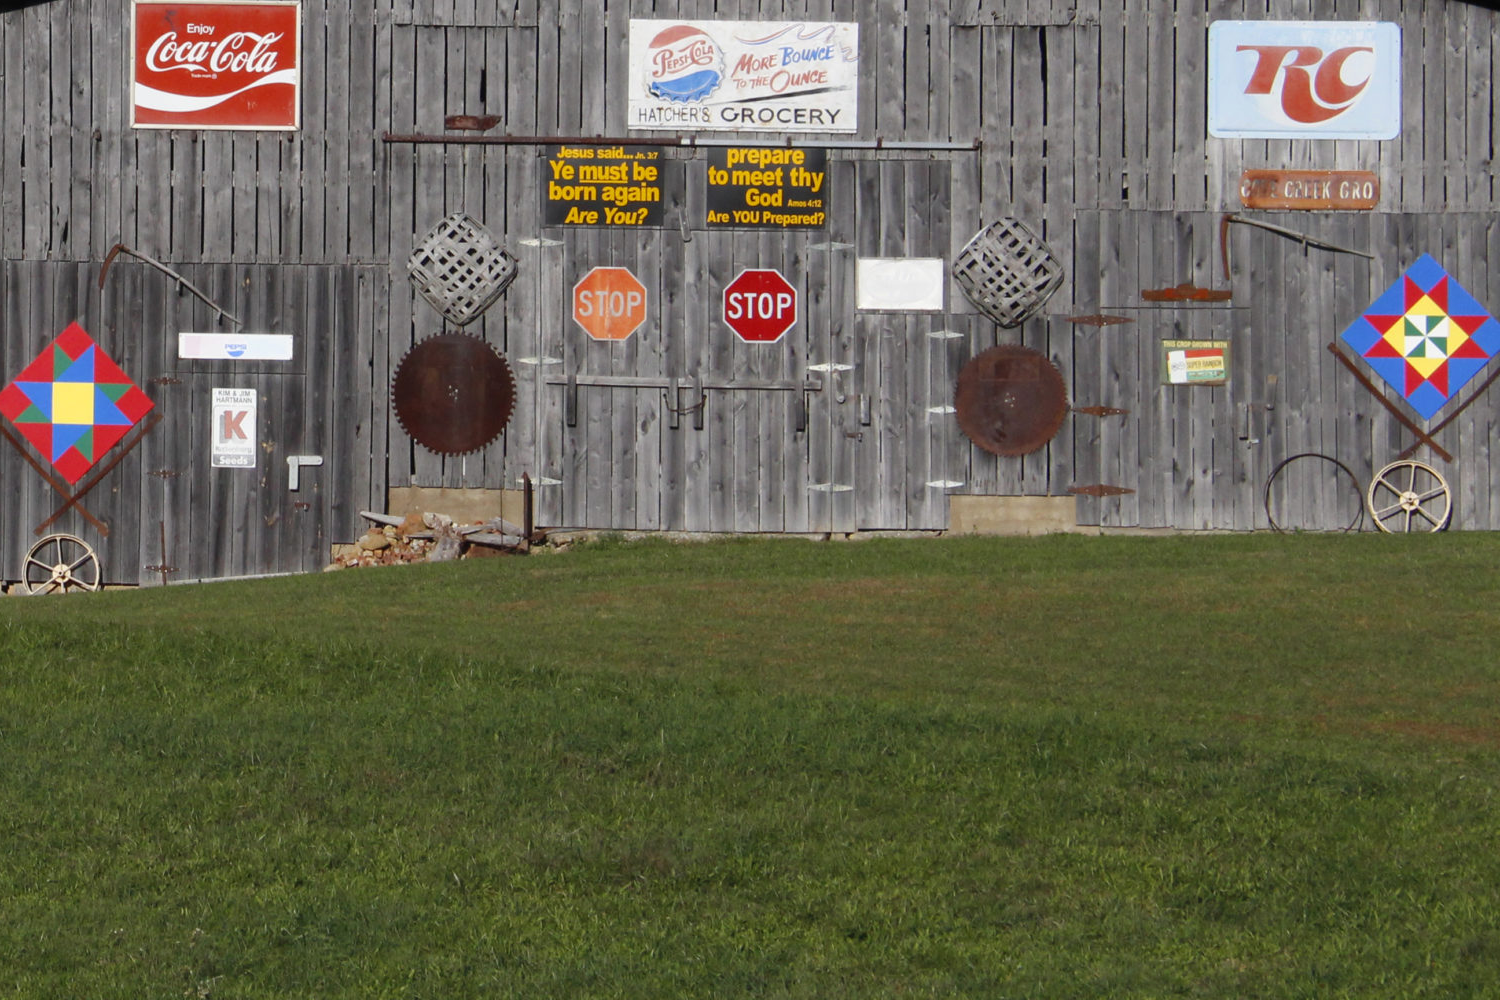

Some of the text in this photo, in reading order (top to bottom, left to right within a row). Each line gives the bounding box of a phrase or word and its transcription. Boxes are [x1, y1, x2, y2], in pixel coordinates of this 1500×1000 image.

[186, 23, 215, 35] Enjoy
[146, 31, 284, 73] Coca-Cola
[731, 44, 835, 78] MORE BOUNCE
[733, 69, 828, 93] TO THE OUNCE
[1236, 45, 1374, 124] RC
[638, 107, 841, 125] HATCHER'S GROCERY
[557, 146, 594, 159] Jesus
[597, 146, 634, 159] said...
[727, 148, 805, 169] prepare
[549, 160, 658, 181] Ye must be
[707, 165, 824, 192] to meet thy
[549, 181, 660, 206] born again
[745, 188, 783, 207] God
[1284, 180, 1331, 200] CREEK
[1339, 181, 1373, 200] GRO
[787, 199, 822, 208] Amos 4:12
[564, 206, 649, 225] Are You?
[707, 210, 825, 227] Are YOU Prepared?
[578, 290, 641, 317] STOP
[727, 292, 792, 320] STOP
[1163, 340, 1176, 348] THIS
[1176, 340, 1191, 348] CROP
[1213, 340, 1228, 348] WITH
[224, 410, 248, 440] K
[219, 456, 248, 465] Seeds
